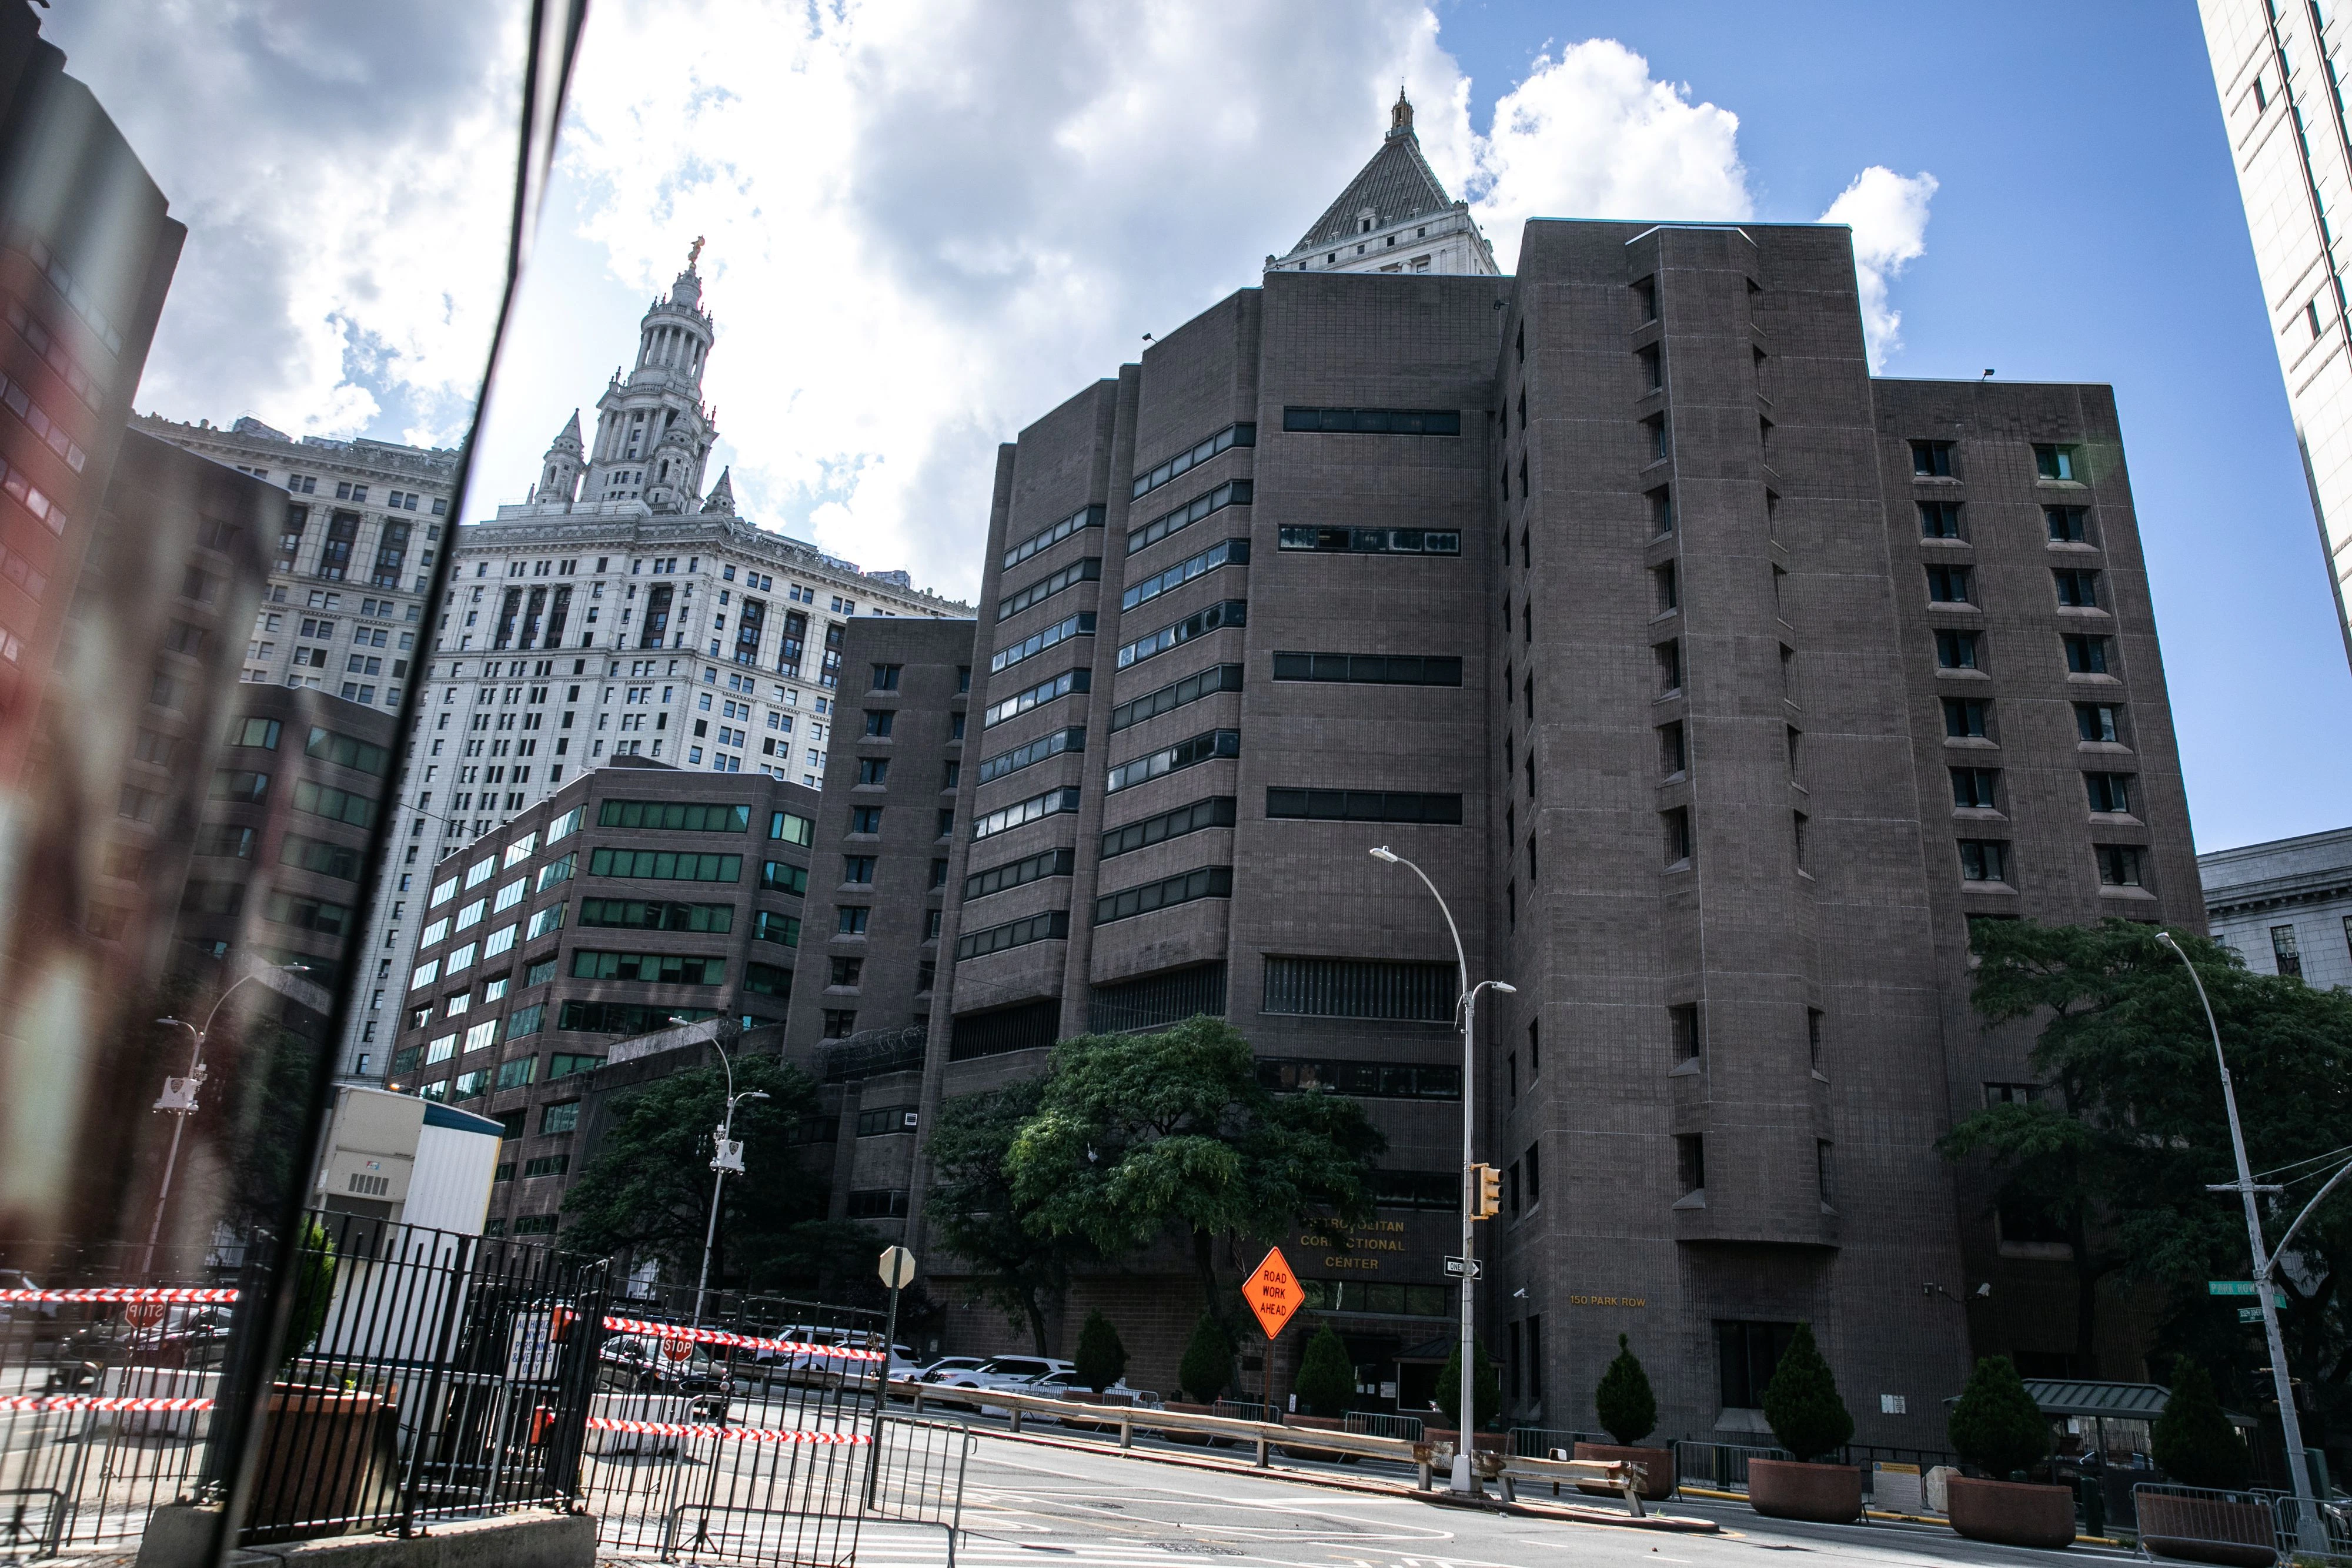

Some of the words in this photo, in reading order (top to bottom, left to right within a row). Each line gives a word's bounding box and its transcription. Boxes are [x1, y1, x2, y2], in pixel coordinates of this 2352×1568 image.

[1302, 1217, 1404, 1232] TROOLITAN
[1300, 1235, 1405, 1251] CORCTIONAL
[1325, 1256, 1378, 1269] CENTER
[1450, 1262, 1461, 1271] ONE
[1264, 1270, 1287, 1284] ROAD
[1262, 1285, 1286, 1299] WORK
[2210, 1283, 2234, 1293] PARK
[2237, 1283, 2256, 1293] ROW
[1571, 1295, 1588, 1305] 150
[1591, 1296, 1618, 1306] PARK
[1622, 1298, 1646, 1307] ROW
[1259, 1302, 1287, 1316] AHEAD
[517, 1319, 555, 1329] AUHORIZ
[527, 1330, 545, 1340] NYD
[514, 1341, 553, 1351] PRSNNL
[664, 1339, 691, 1353] STOP
[512, 1352, 518, 1362] &
[522, 1363, 539, 1373] OY
